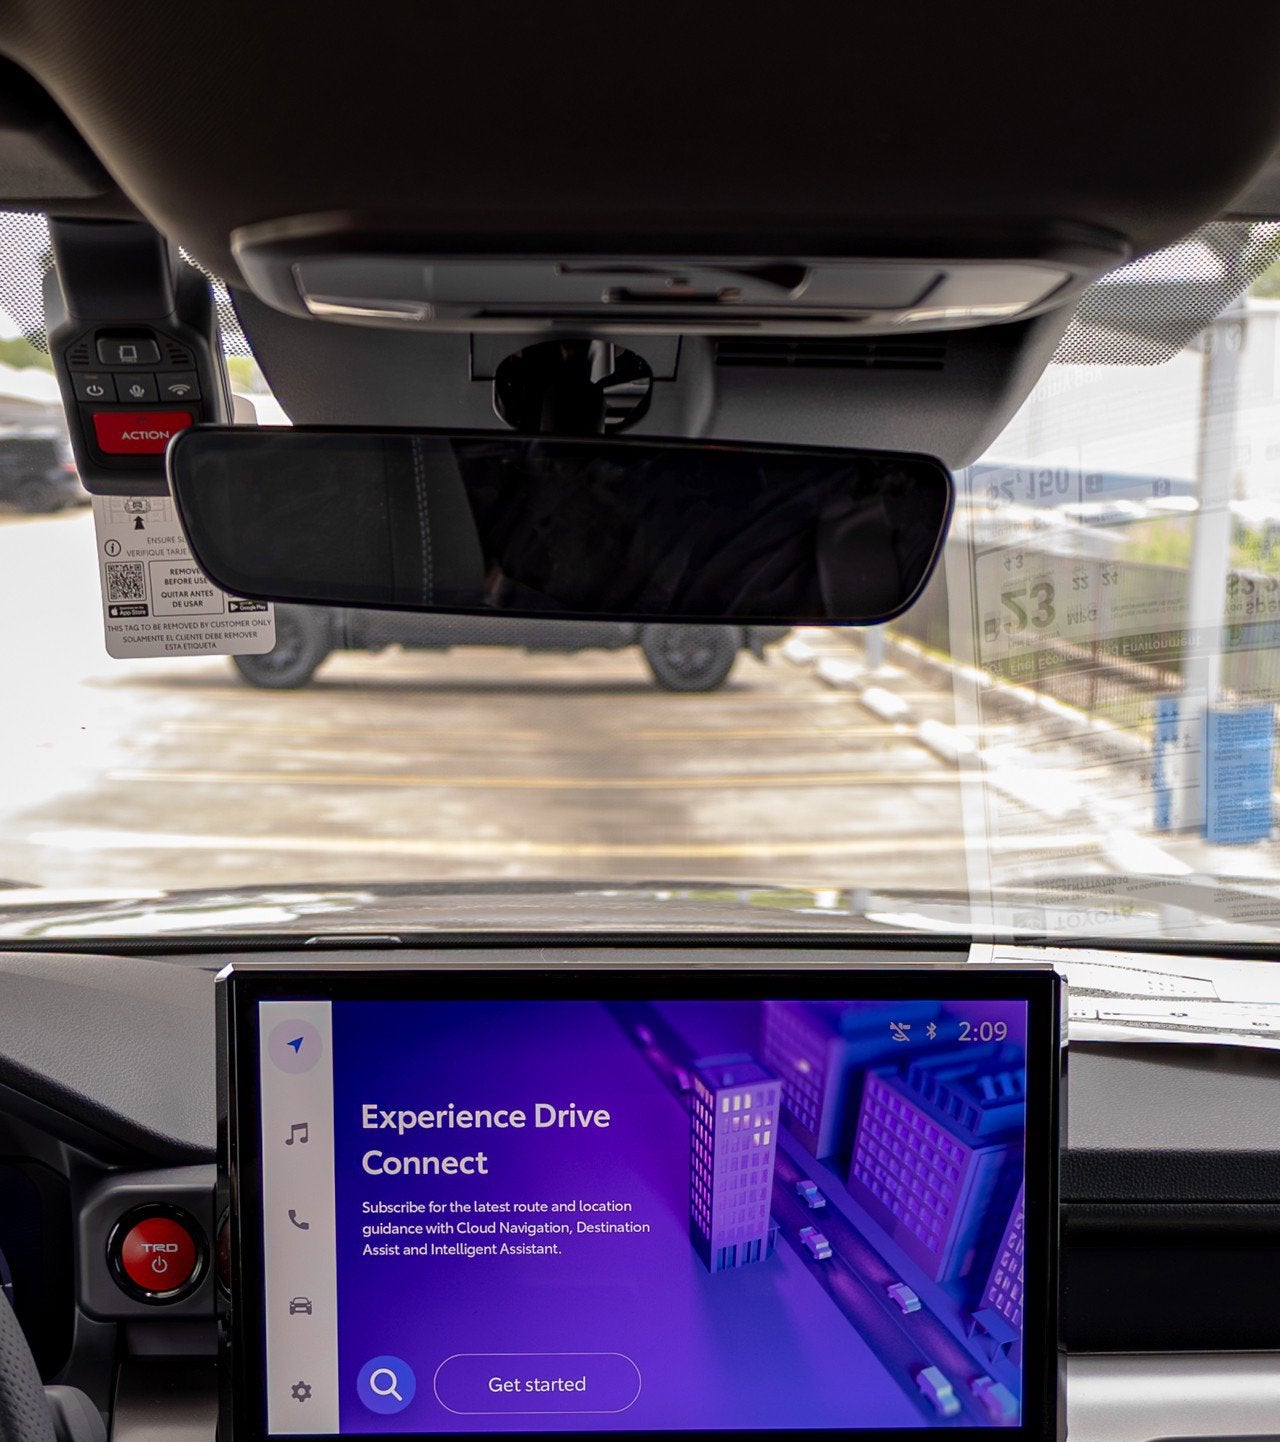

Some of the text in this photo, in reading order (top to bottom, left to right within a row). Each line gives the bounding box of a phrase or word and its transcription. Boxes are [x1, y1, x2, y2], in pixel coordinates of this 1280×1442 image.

[122, 431, 169, 440] ACTION
[163, 622, 198, 630] REMOVED
[211, 620, 249, 628] CUSTOMER
[959, 1022, 1007, 1041] 2:09
[362, 1102, 611, 1136] Experience Drive
[362, 1150, 488, 1175] Connect
[362, 1200, 632, 1214] Subscribe for the latest route and location
[362, 1221, 650, 1237] guidance with Cloud Navigation, Destination
[140, 1243, 178, 1252] TRD
[362, 1242, 562, 1258] Assist and Intelligent Assistant.
[488, 1376, 586, 1392] Get started
